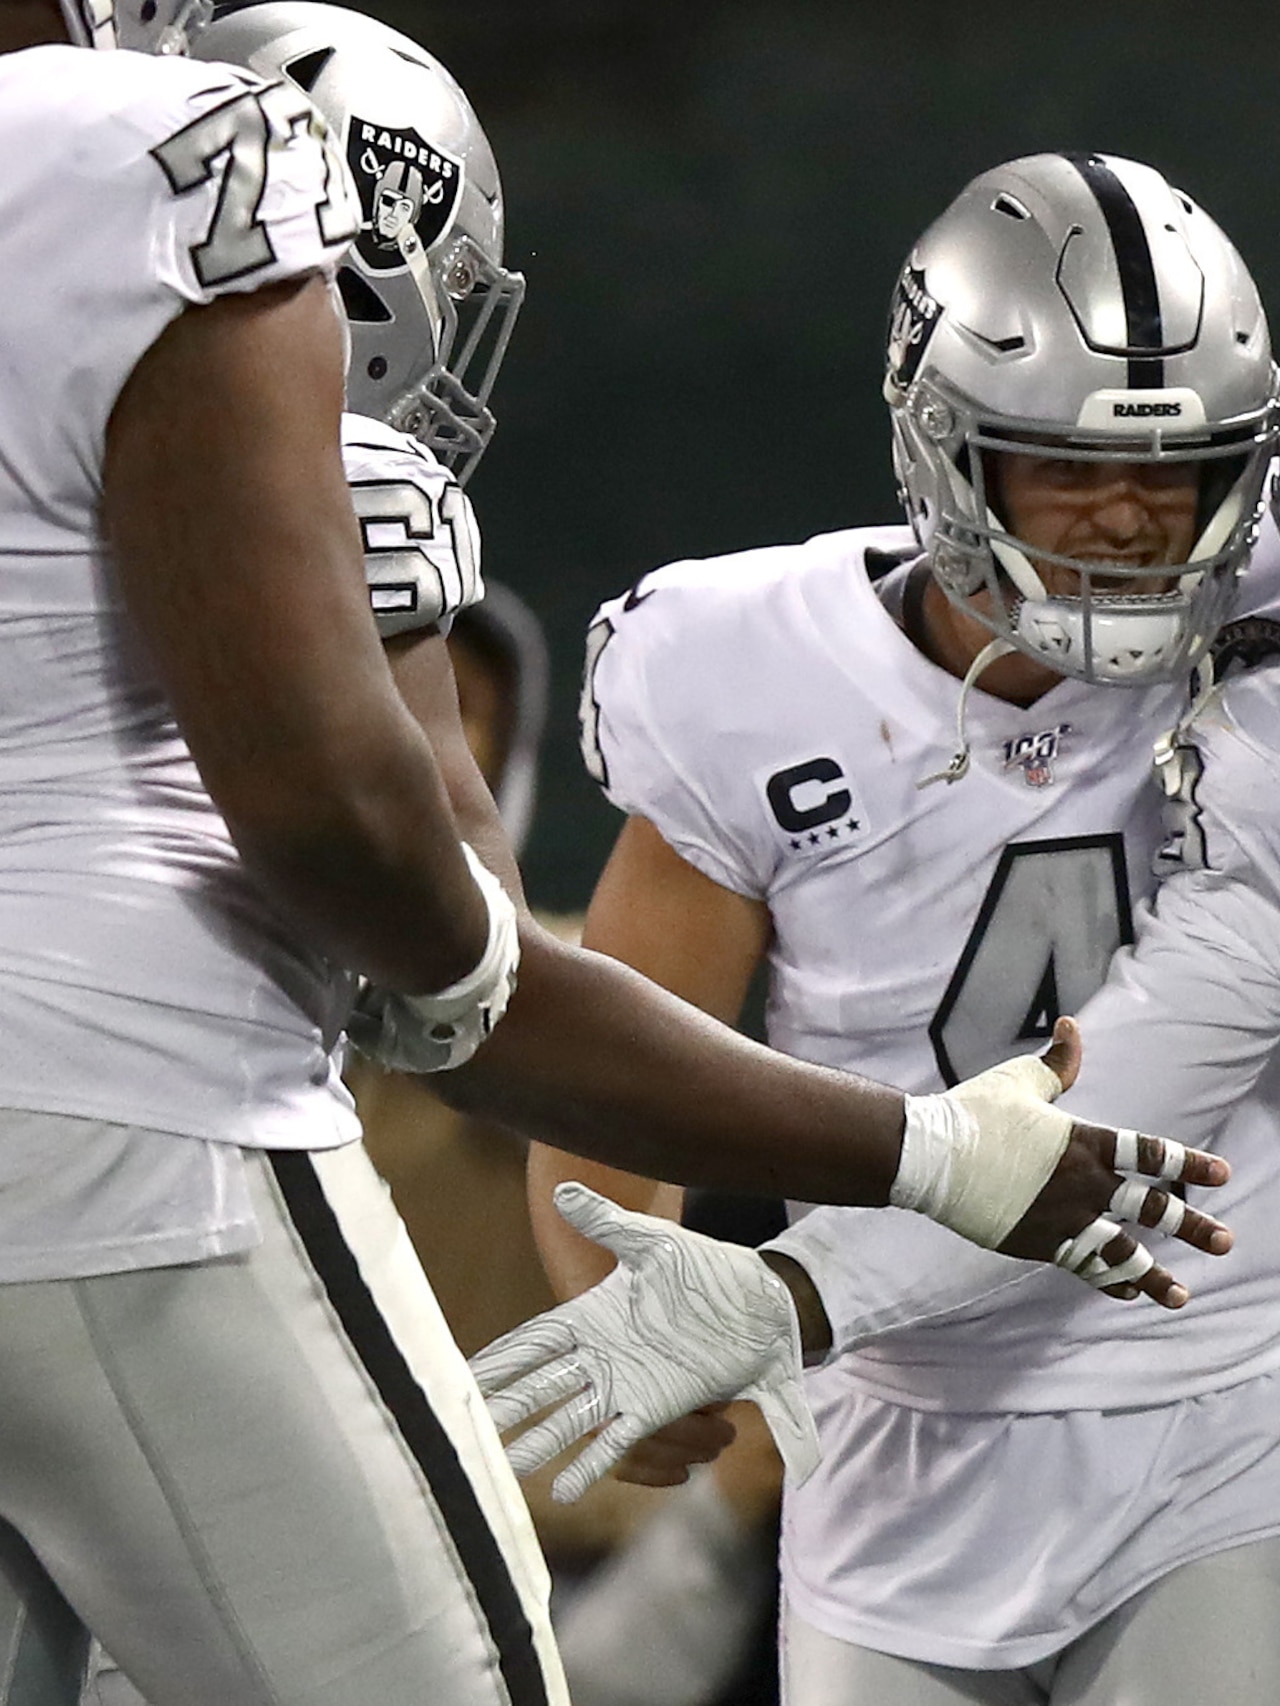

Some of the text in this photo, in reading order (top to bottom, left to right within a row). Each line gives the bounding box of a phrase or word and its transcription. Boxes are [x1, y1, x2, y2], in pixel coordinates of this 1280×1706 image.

[361, 122, 454, 179] RAIDERS
[1112, 402, 1182, 417] RAIDERS
[346, 478, 477, 638] 61
[765, 756, 853, 834] C
[927, 831, 1136, 1091] 4
